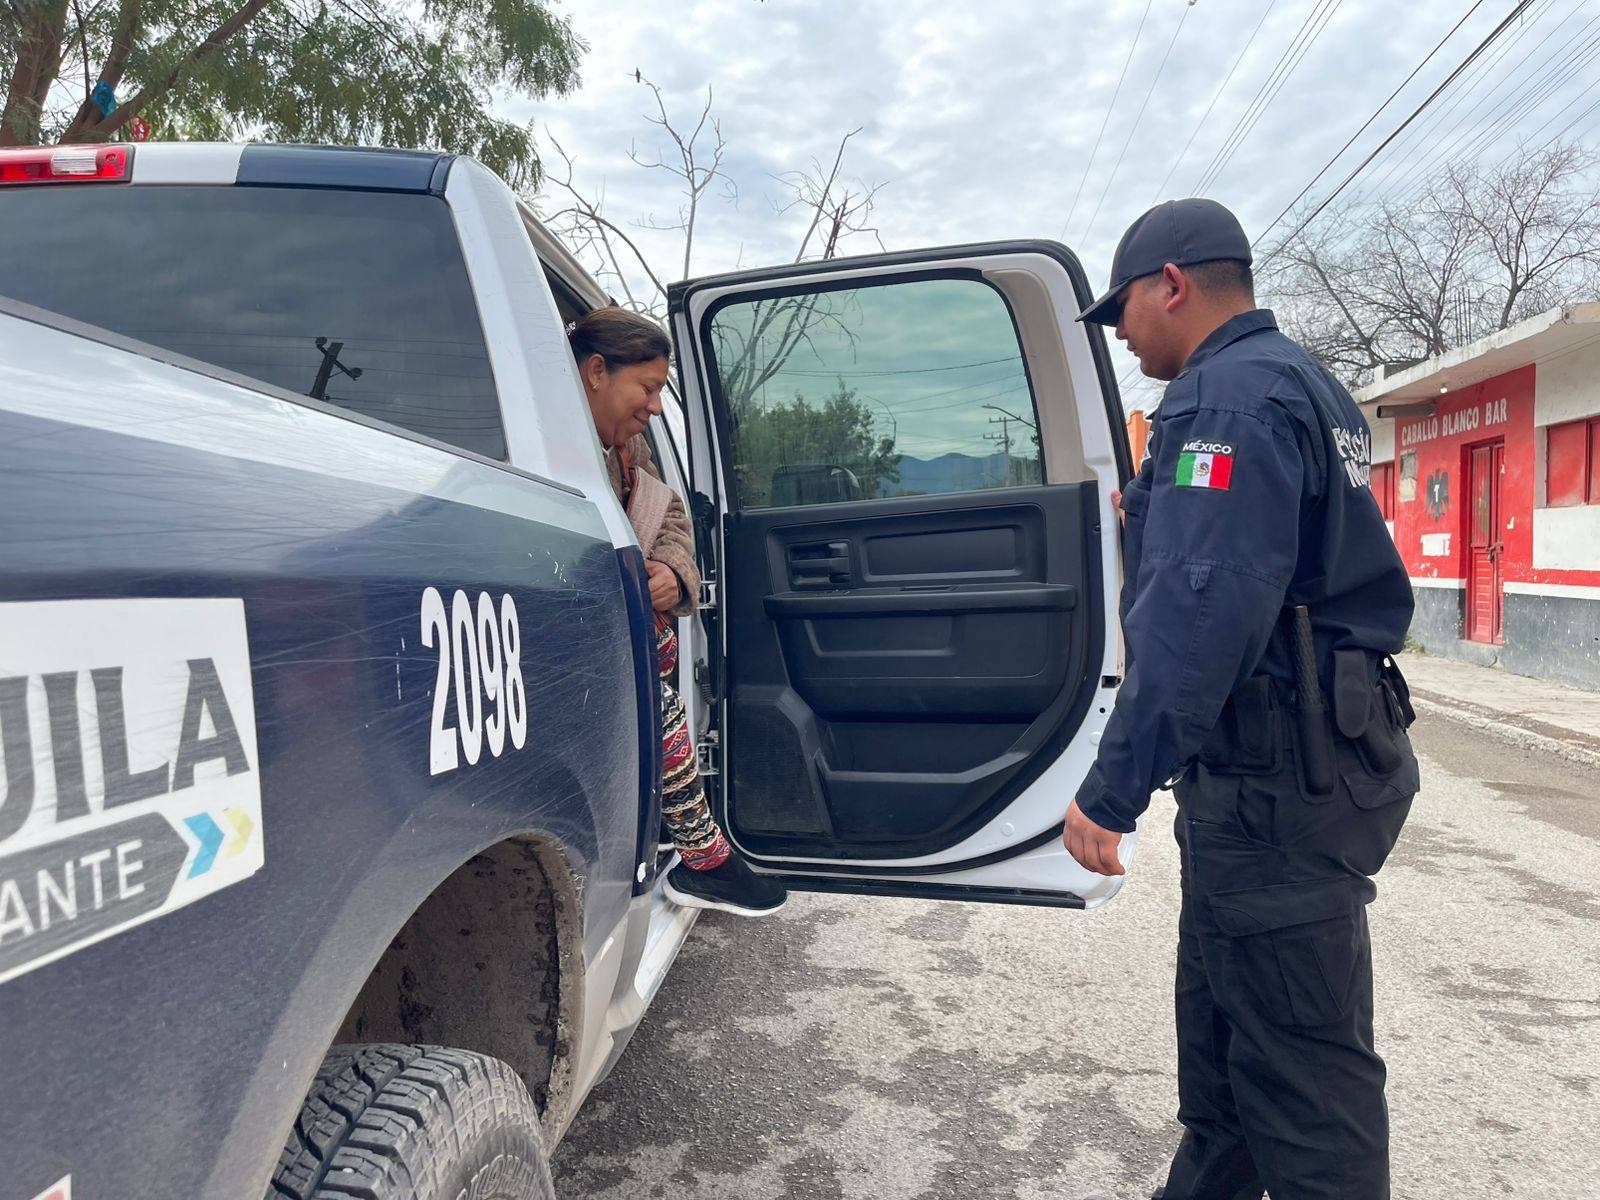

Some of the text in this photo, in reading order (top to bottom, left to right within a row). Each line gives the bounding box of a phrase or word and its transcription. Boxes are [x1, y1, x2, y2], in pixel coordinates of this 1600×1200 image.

[1182, 439, 1232, 454] MÉXICO
[1401, 417, 1438, 447] CABALLO
[1442, 406, 1479, 437] BLANCO
[1485, 398, 1508, 426] BAR
[420, 586, 527, 776] 2098
[0, 839, 145, 943] ANTE
